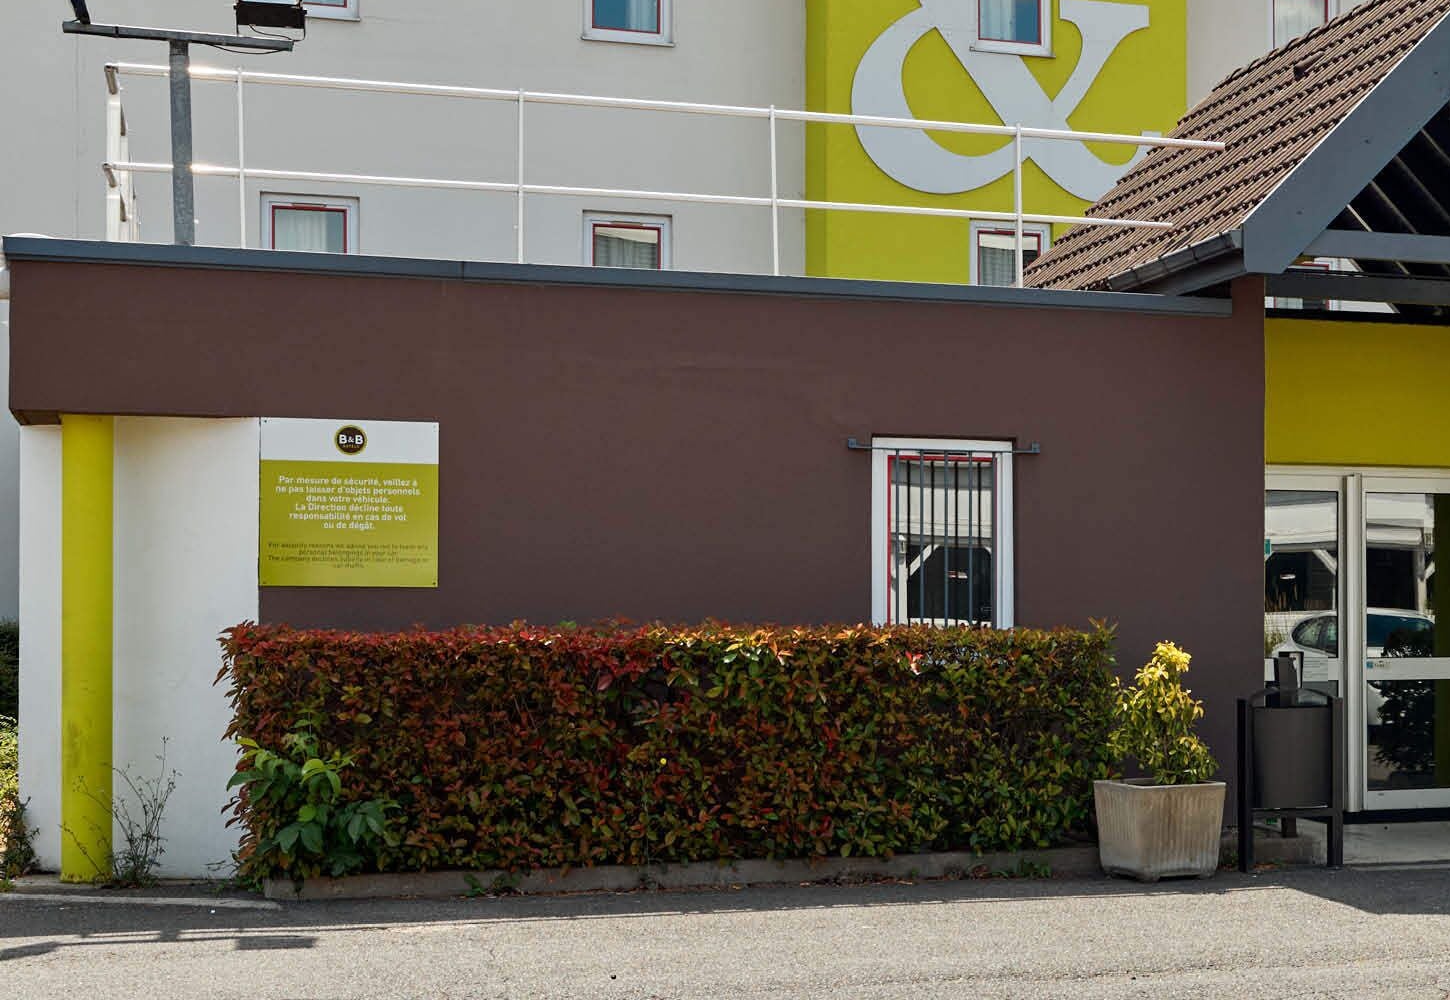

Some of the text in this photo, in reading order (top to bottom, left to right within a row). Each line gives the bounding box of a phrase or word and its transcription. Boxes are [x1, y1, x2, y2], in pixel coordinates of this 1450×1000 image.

[338, 434, 364, 445] B&B
[279, 476, 293, 484] Par
[331, 477, 342, 485] de
[289, 487, 304, 495] pas
[373, 488, 420, 497] personnels
[381, 504, 404, 512] toute
[381, 513, 392, 521] de
[336, 521, 347, 529] de
